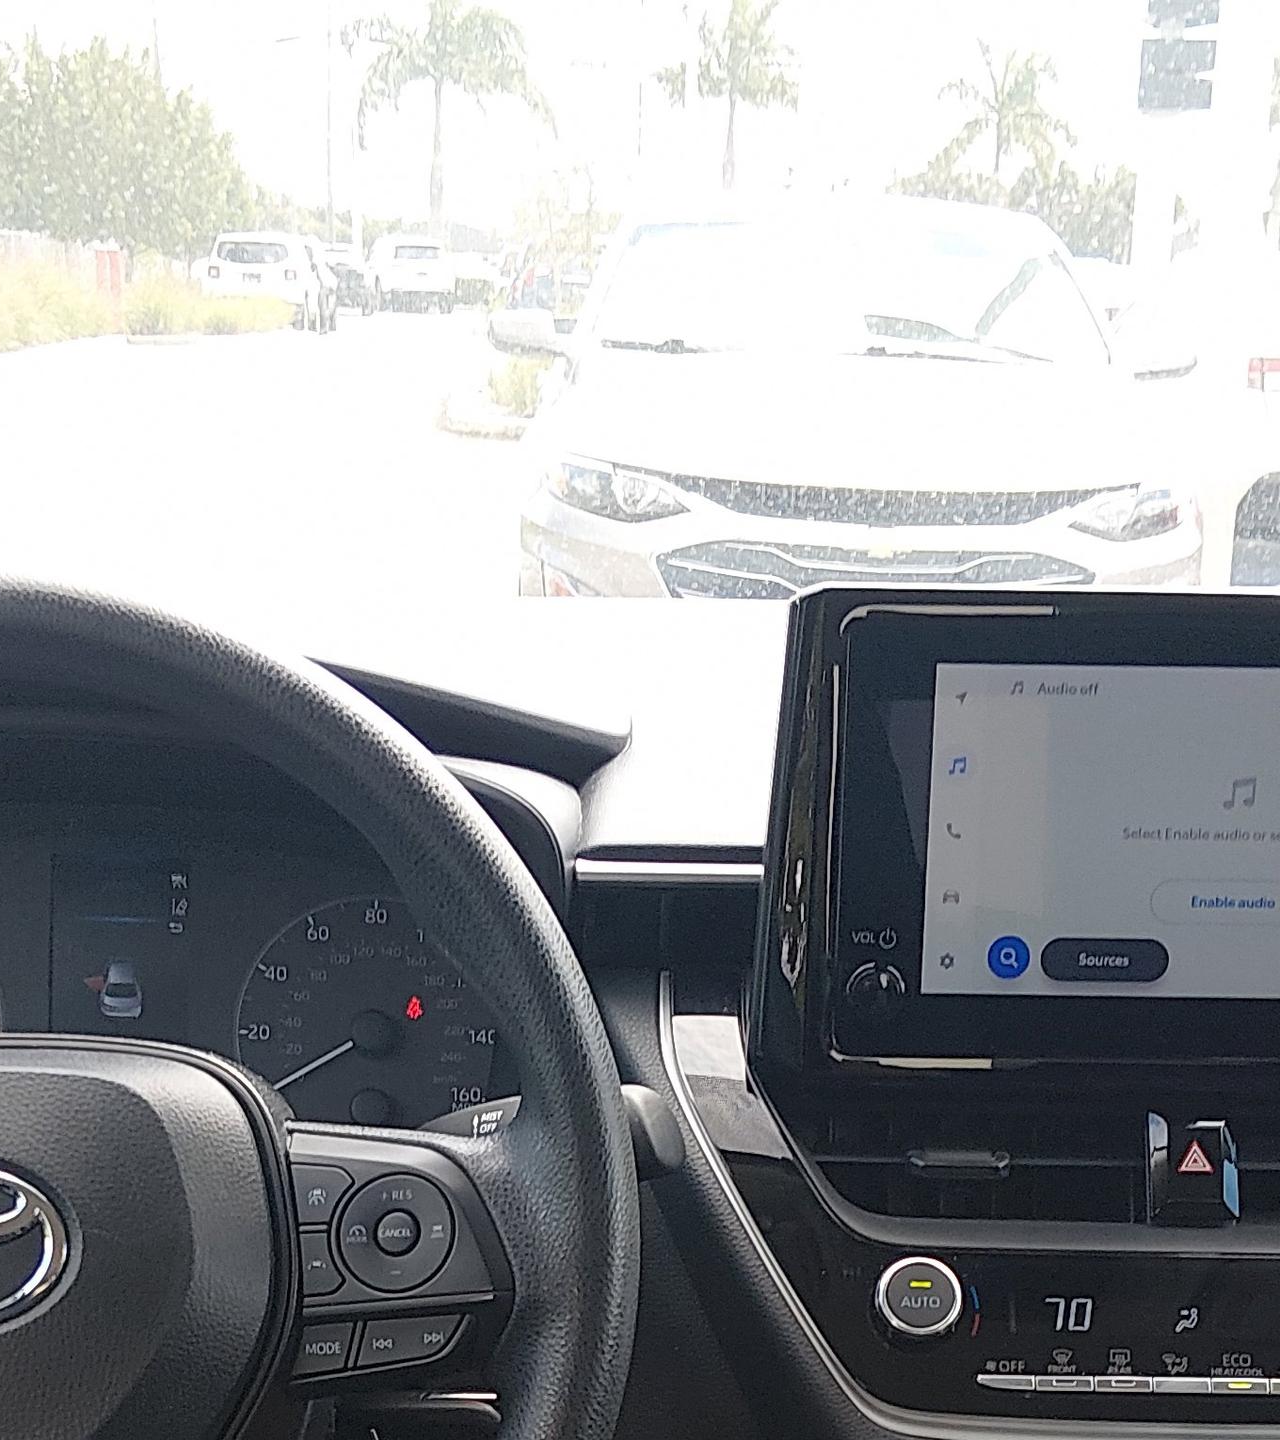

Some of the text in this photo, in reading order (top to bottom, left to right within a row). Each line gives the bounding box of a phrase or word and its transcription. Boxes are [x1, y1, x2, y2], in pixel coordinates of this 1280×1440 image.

[1037, 682, 1099, 696] Audio off
[1122, 827, 1161, 841] Select
[1165, 827, 1210, 841] Enable
[1213, 827, 1250, 842] audio
[1253, 831, 1267, 842] or
[1191, 895, 1276, 910] Enable audio
[364, 909, 388, 925] 80
[306, 926, 330, 942] 60
[851, 930, 876, 945] VOL
[1078, 951, 1130, 967] Sources
[264, 966, 288, 982] 40
[248, 1024, 270, 1041] 20
[451, 1086, 481, 1103] 160
[379, 1227, 412, 1238] CANCEL
[900, 1295, 941, 1309] AUTO
[1044, 1297, 1093, 1332] 70
[305, 1341, 342, 1355] MODE
[998, 1360, 1026, 1373] OFF
[1222, 1354, 1252, 1367] ECO
